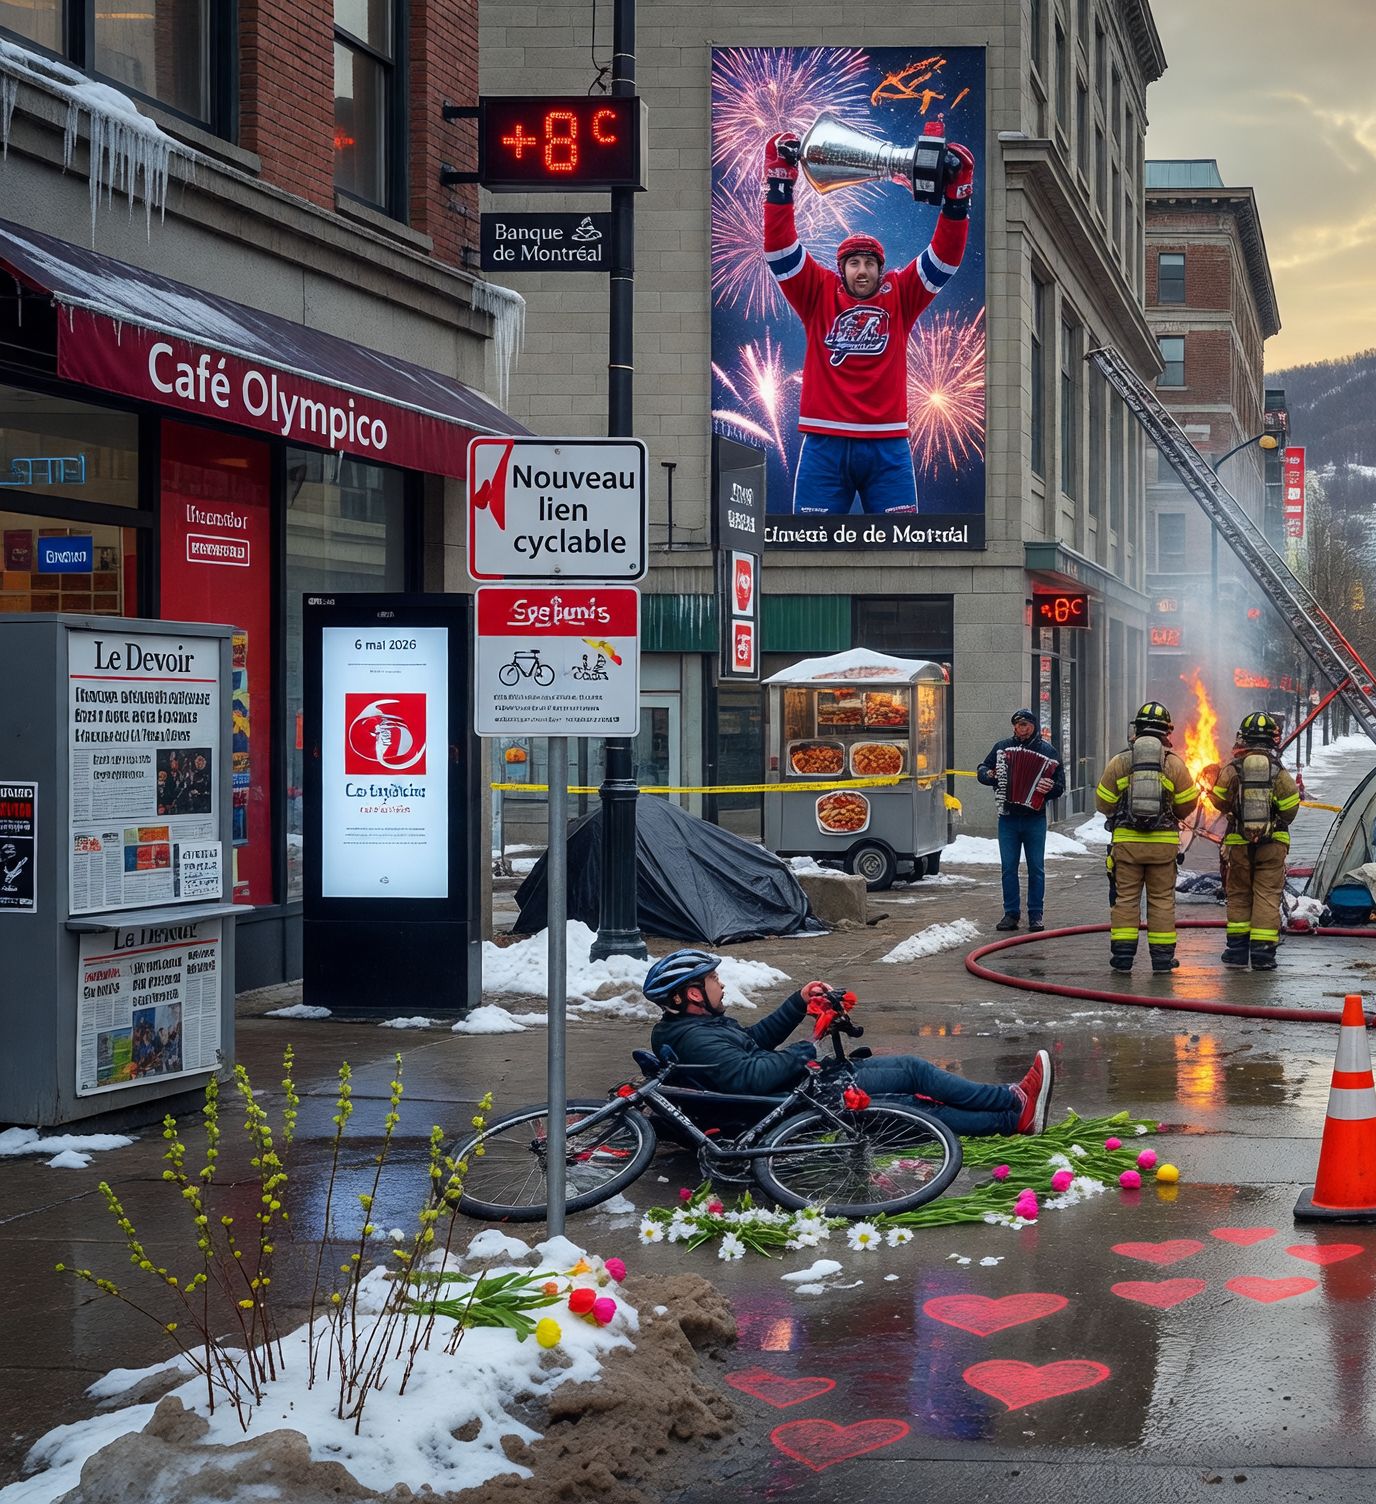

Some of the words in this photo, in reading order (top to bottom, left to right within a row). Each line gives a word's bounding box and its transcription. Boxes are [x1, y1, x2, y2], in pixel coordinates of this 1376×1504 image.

[495, 223, 564, 246] Banque
[493, 247, 516, 262] de
[521, 244, 602, 262] Montréal
[148, 342, 231, 408] Café
[242, 370, 388, 450] Olympico
[512, 465, 636, 490] Nouveau
[539, 496, 588, 522] lien
[513, 529, 627, 559] cyclable
[833, 524, 857, 543] de
[862, 524, 887, 543] de
[354, 639, 362, 650] 6
[389, 639, 417, 650] 2026
[94, 641, 121, 670] Le
[124, 642, 195, 673] Devoir
[113, 927, 136, 951] Le
